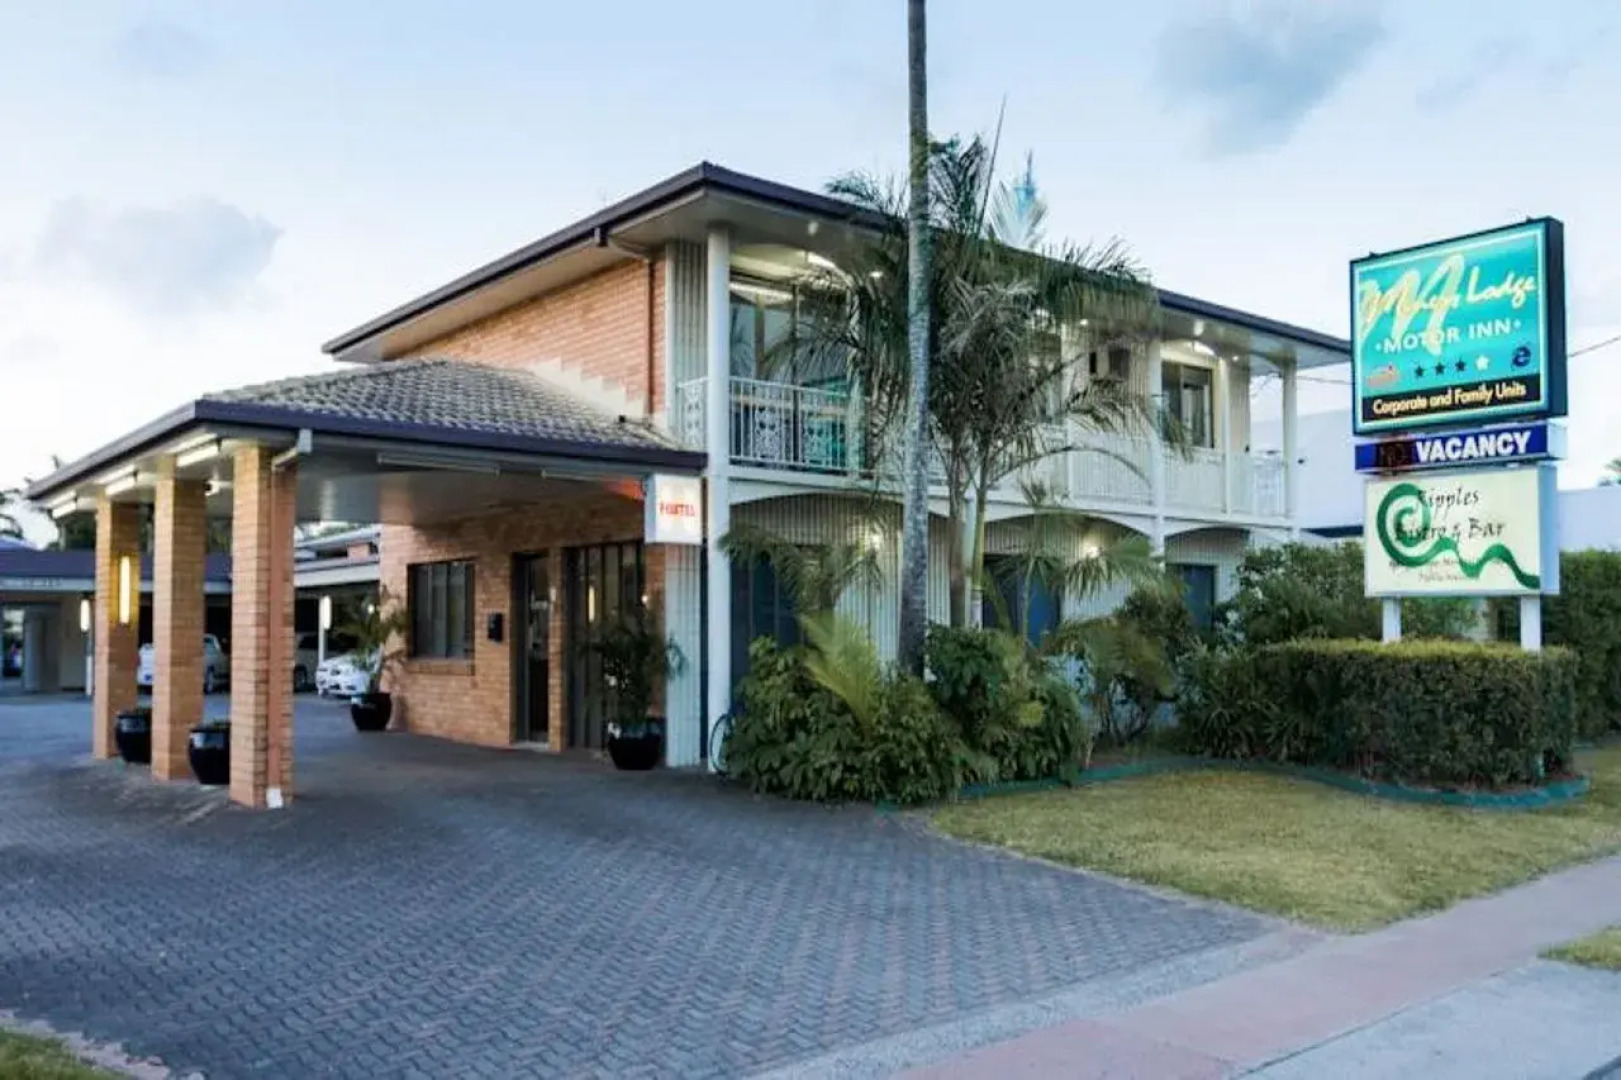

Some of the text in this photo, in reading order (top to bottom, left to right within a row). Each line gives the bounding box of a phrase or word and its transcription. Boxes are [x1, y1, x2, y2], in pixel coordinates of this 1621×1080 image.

[1467, 265, 1535, 309] Lodge
[1384, 319, 1510, 354] MOTOR INN
[1373, 382, 1526, 415] Corporate and Family Units
[1416, 432, 1531, 462] VACANCY
[1469, 517, 1504, 538] Bar
